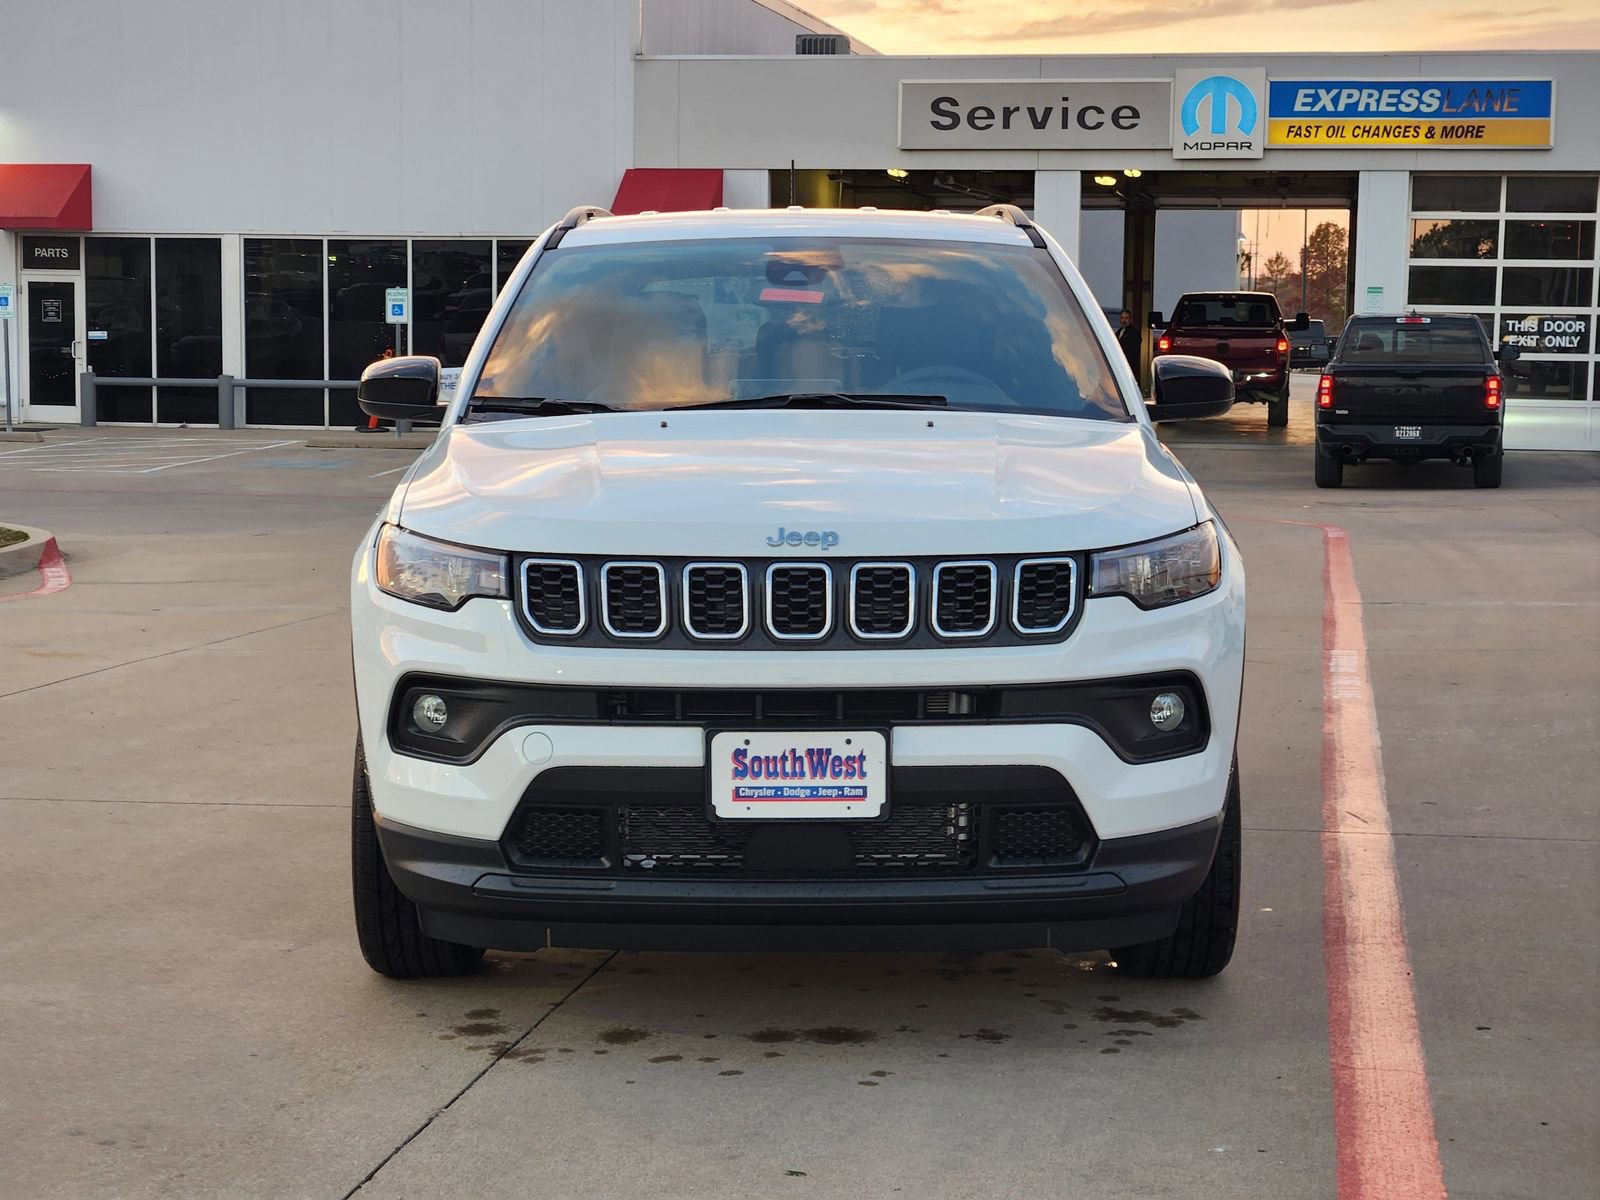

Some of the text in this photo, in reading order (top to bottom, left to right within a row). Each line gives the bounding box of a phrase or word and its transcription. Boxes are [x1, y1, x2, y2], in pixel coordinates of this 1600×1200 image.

[930, 96, 1141, 131] Service
[1286, 125, 1486, 139] FAST OIL CHANGES & MORE
[1183, 142, 1253, 151] MOPAR
[34, 247, 69, 258] PARTS
[1506, 320, 1586, 333] THIS DOOR
[1508, 334, 1581, 348] EXIT ONLY
[766, 527, 839, 550] Jeep
[731, 747, 867, 780] SouthWest
[739, 787, 863, 797] Chrysler Dodge Jeep Ram
